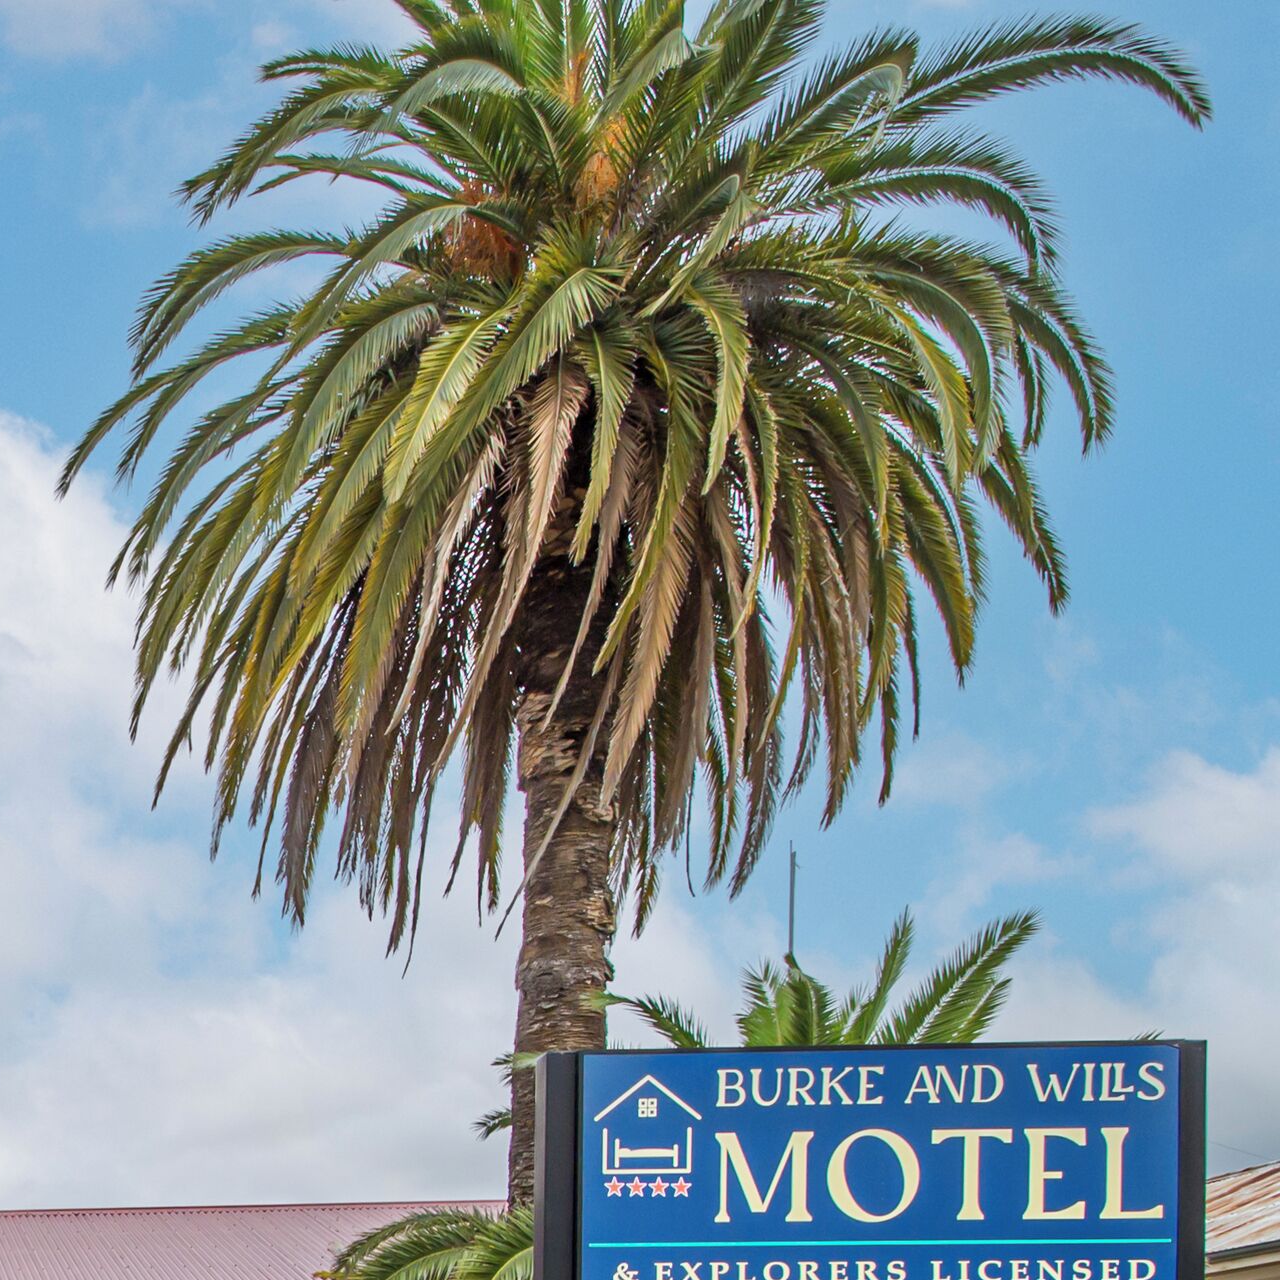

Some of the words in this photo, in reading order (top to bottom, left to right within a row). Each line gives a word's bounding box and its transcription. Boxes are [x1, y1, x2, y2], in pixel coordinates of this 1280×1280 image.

[715, 1066, 885, 1107] BURKE
[904, 1065, 1005, 1103] AND
[1026, 1062, 1166, 1101] WILLS
[714, 1127, 1164, 1223] MOTEL
